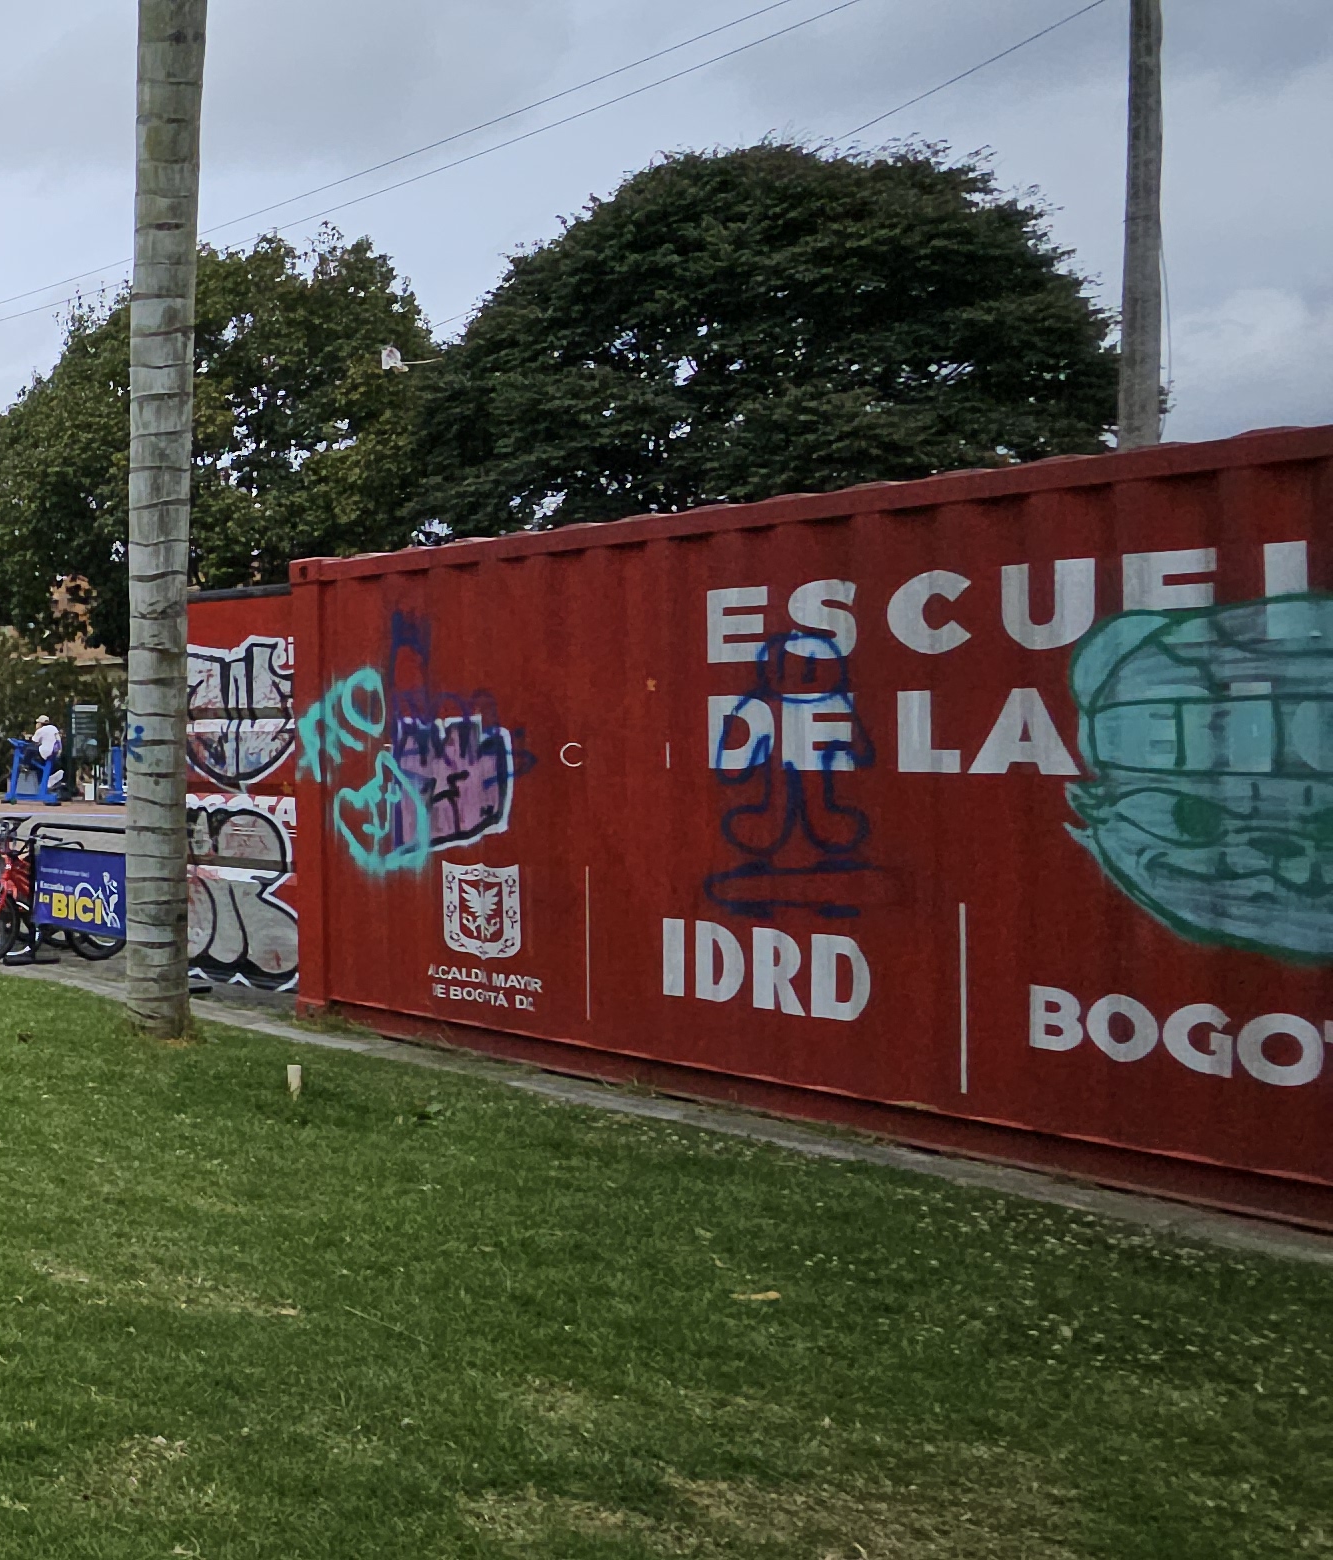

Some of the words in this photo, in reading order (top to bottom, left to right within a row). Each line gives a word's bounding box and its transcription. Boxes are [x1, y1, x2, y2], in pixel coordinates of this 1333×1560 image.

[707, 693, 857, 772] DE
[896, 687, 1081, 776] LA
[52, 892, 102, 924] BICI
[428, 963, 489, 985] ALCALDA
[449, 985, 509, 1007] BOGTÁ
[662, 917, 871, 1022] IDRD
[1029, 983, 1333, 1087] BOGO
